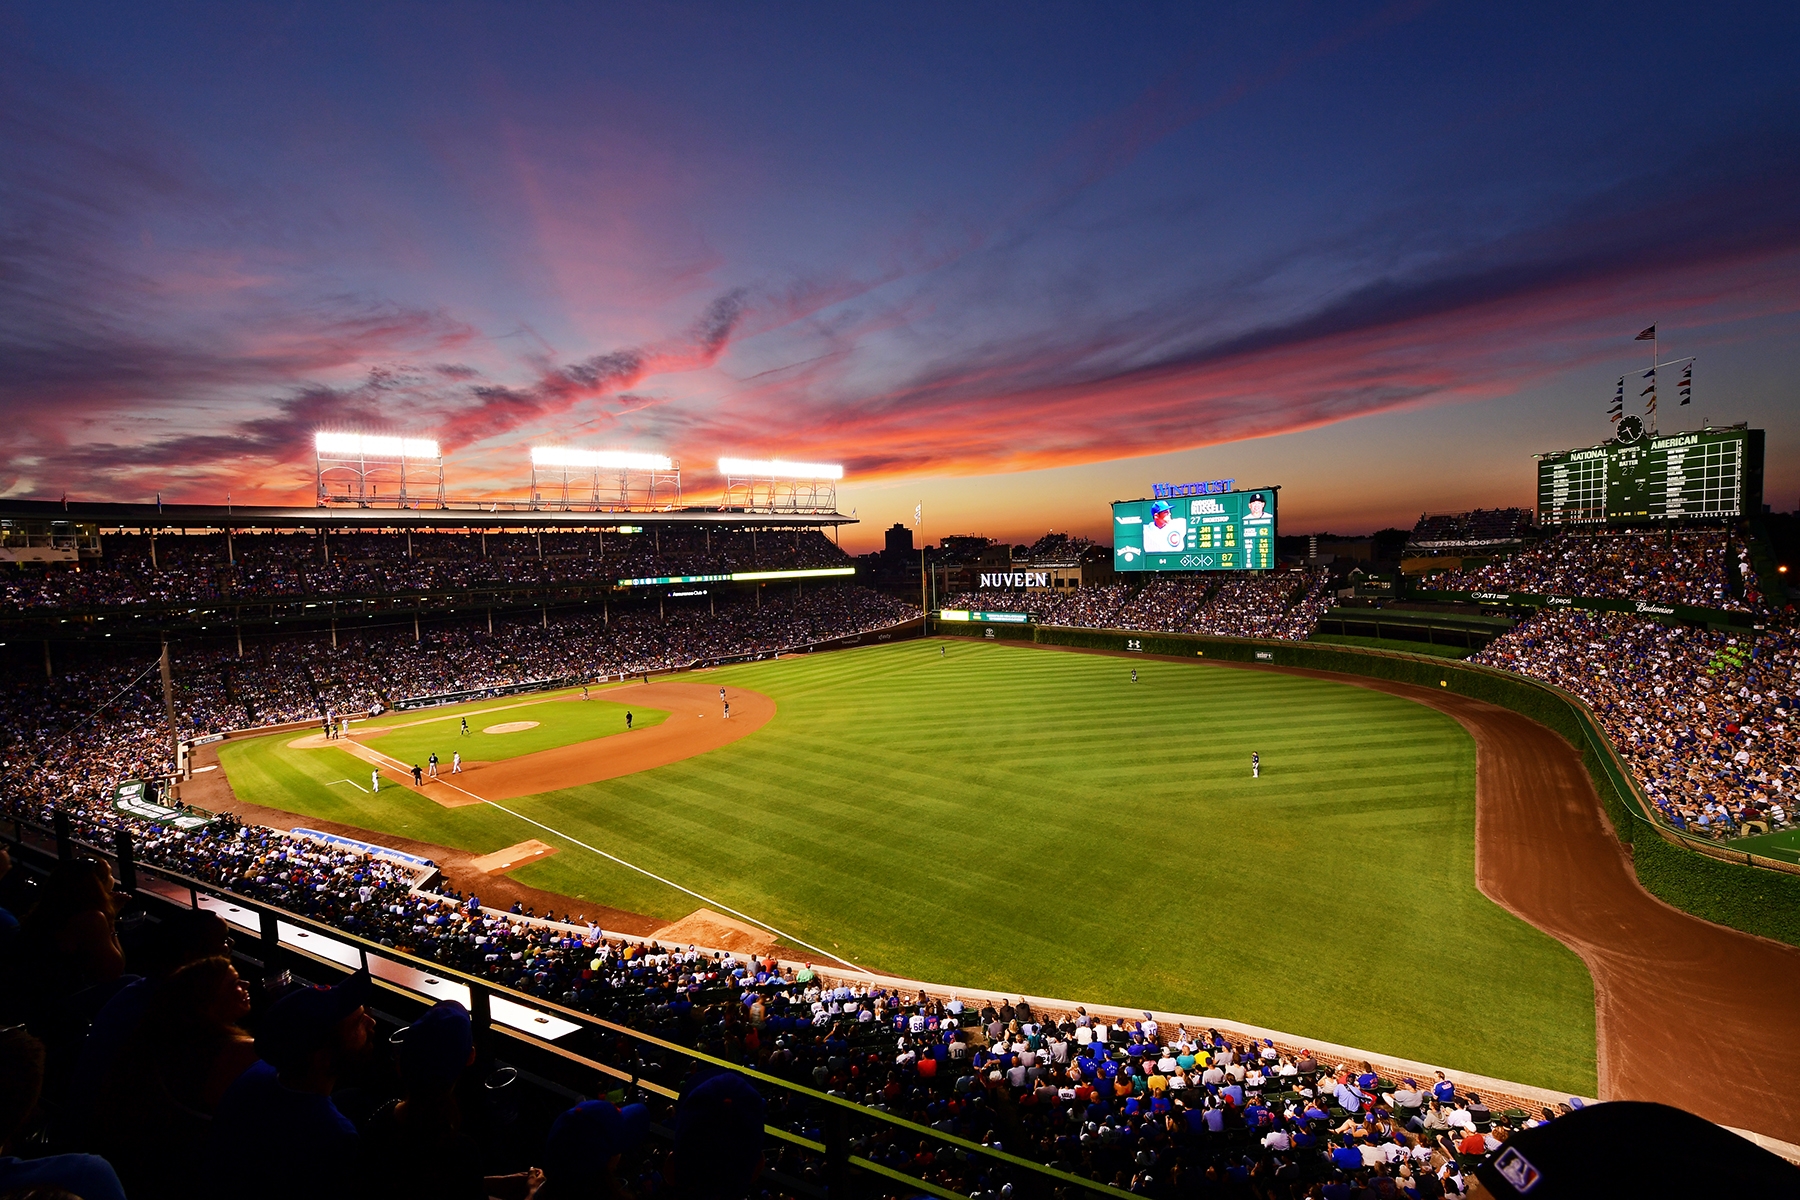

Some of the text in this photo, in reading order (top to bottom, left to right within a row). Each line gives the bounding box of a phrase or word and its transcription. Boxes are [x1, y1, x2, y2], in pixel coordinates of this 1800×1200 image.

[1650, 434, 1698, 450] AMERICAN
[1570, 449, 1608, 462] NATIONAL
[1190, 516, 1200, 524] 27
[1259, 528, 1268, 536] 62
[980, 573, 1048, 588] NUVEEN
[1635, 602, 1675, 614] Budweiser
[914, 1023, 923, 1031] 68
[954, 1049, 964, 1057] 10
